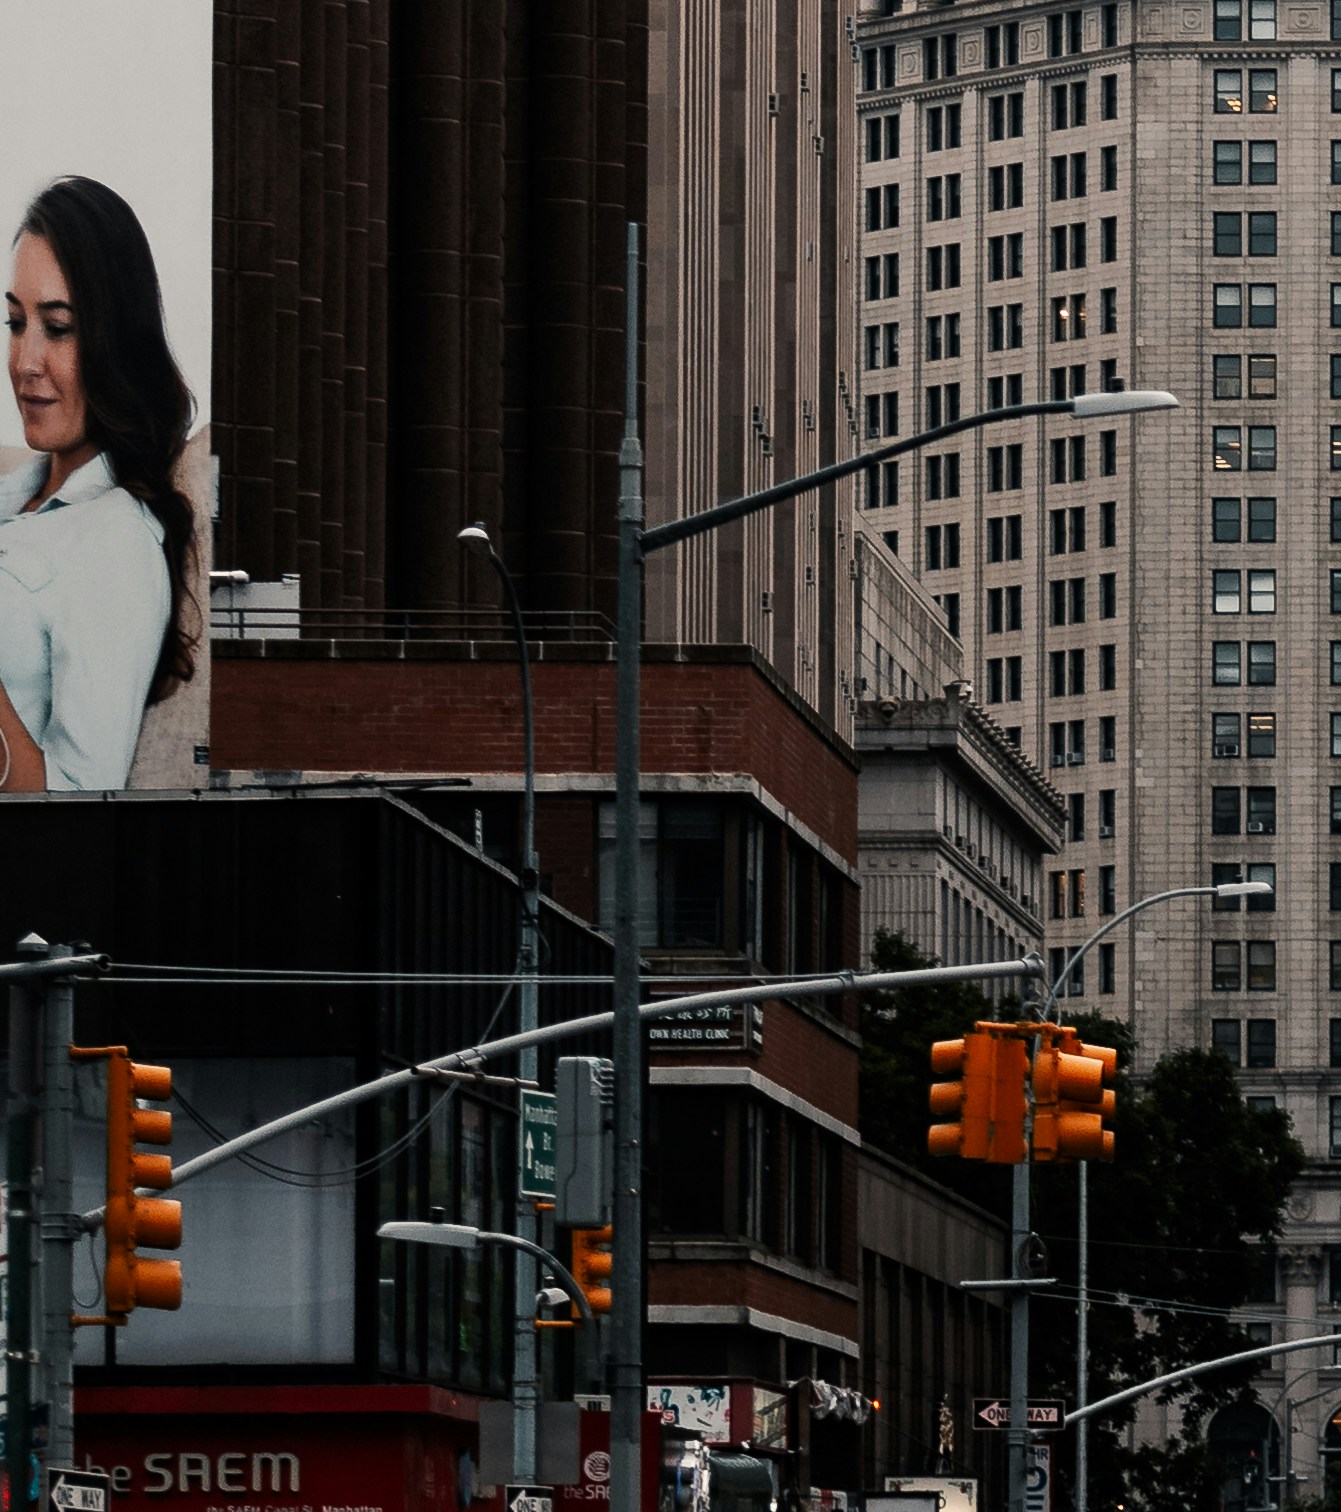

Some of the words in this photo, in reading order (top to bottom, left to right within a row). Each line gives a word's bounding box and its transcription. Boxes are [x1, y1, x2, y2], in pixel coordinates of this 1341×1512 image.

[649, 1028, 669, 1040] OWN
[987, 1409, 1011, 1421] ONE
[143, 1451, 301, 1495] SAEM
[563, 1485, 584, 1499] the
[81, 1489, 102, 1511] WAY
